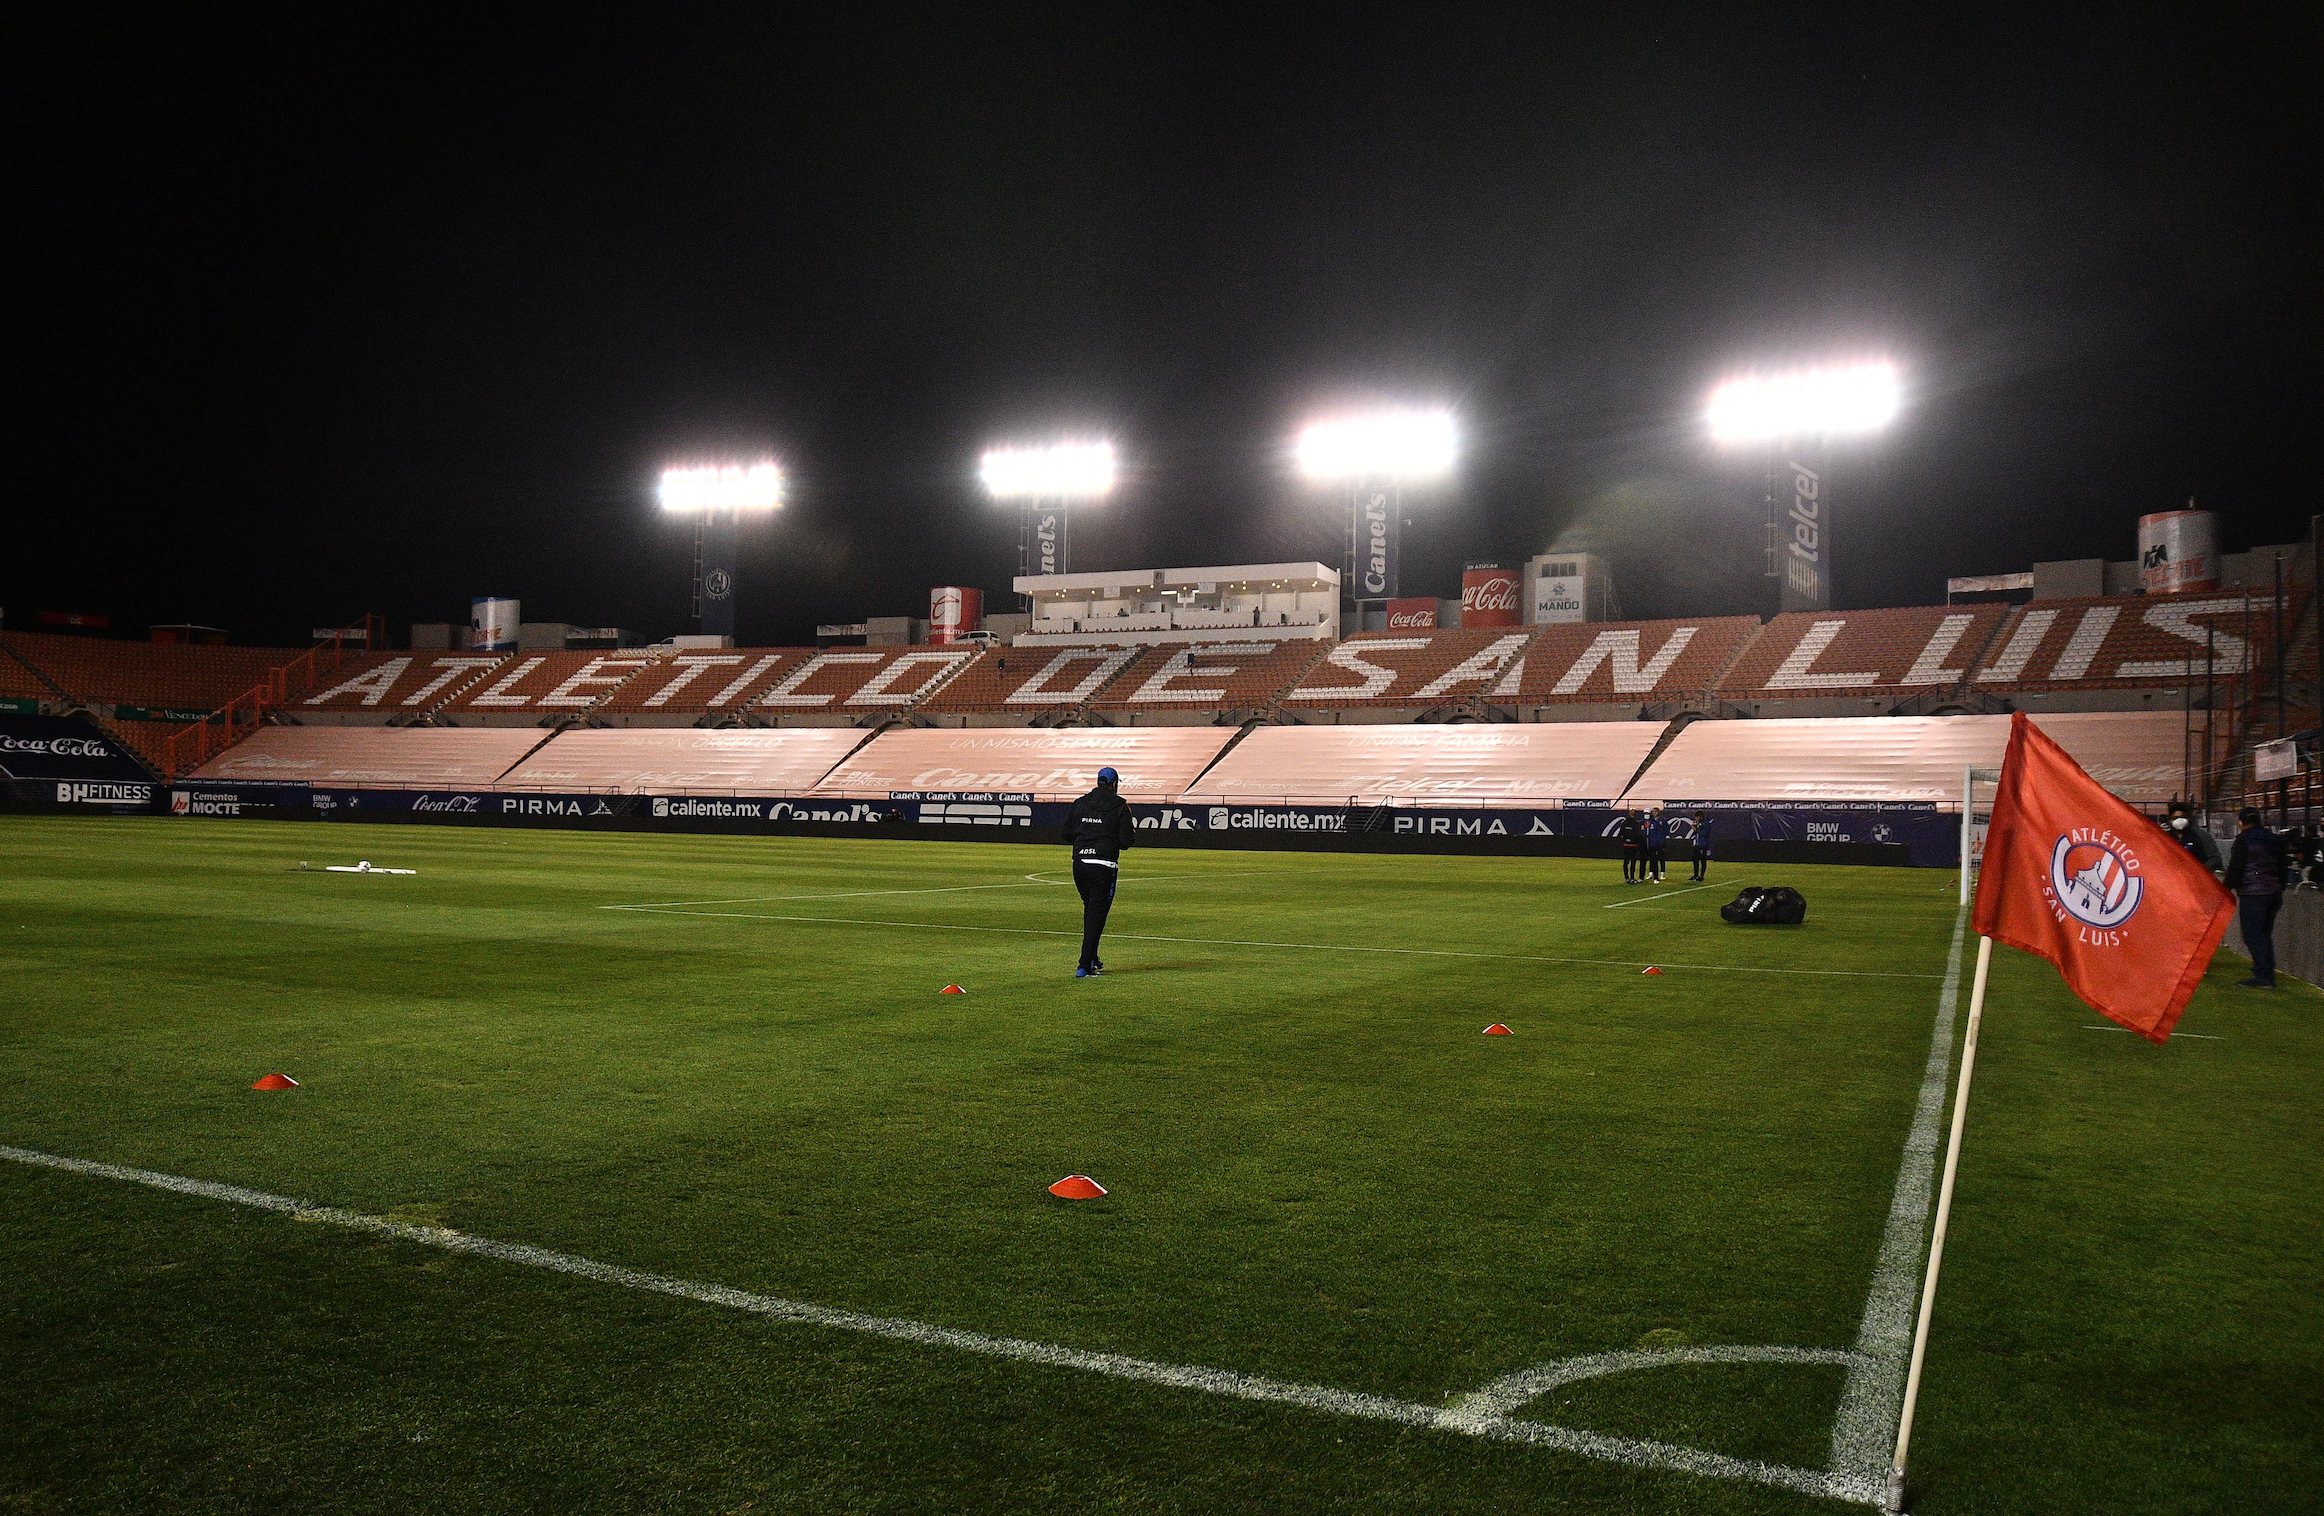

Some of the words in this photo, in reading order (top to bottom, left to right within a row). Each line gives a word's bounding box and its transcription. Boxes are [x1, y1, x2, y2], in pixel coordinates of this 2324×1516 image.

[1789, 460, 1820, 562] telcel
[1037, 514, 1057, 575] nel's
[1364, 493, 1387, 593] Canel's
[1462, 577, 1520, 612] ca-Cola
[1539, 601, 1580, 611] MANDO
[1390, 611, 1434, 629] Coca-Cola
[1006, 642, 1278, 704] DE
[1289, 627, 1700, 699] SAN
[1764, 596, 2289, 691] LUIS
[57, 783, 88, 802] BH
[88, 785, 151, 801] FITNESS
[192, 791, 238, 801] Cementos
[312, 794, 331, 802] BMW
[890, 791, 921, 801] Canel's
[926, 792, 957, 801] Canel's
[962, 792, 993, 802] Canel's
[998, 793, 1031, 802] Canel's
[503, 799, 583, 816] PIRMA
[669, 799, 761, 818] caliente.mx
[1230, 809, 1347, 831] caliente.mx
[1394, 816, 1507, 836] PIRMA
[1806, 822, 1840, 834] BMW
[2071, 827, 2141, 871] ATLÉTICO
[2042, 886, 2066, 924] SAN
[2079, 926, 2120, 947] LUIS
